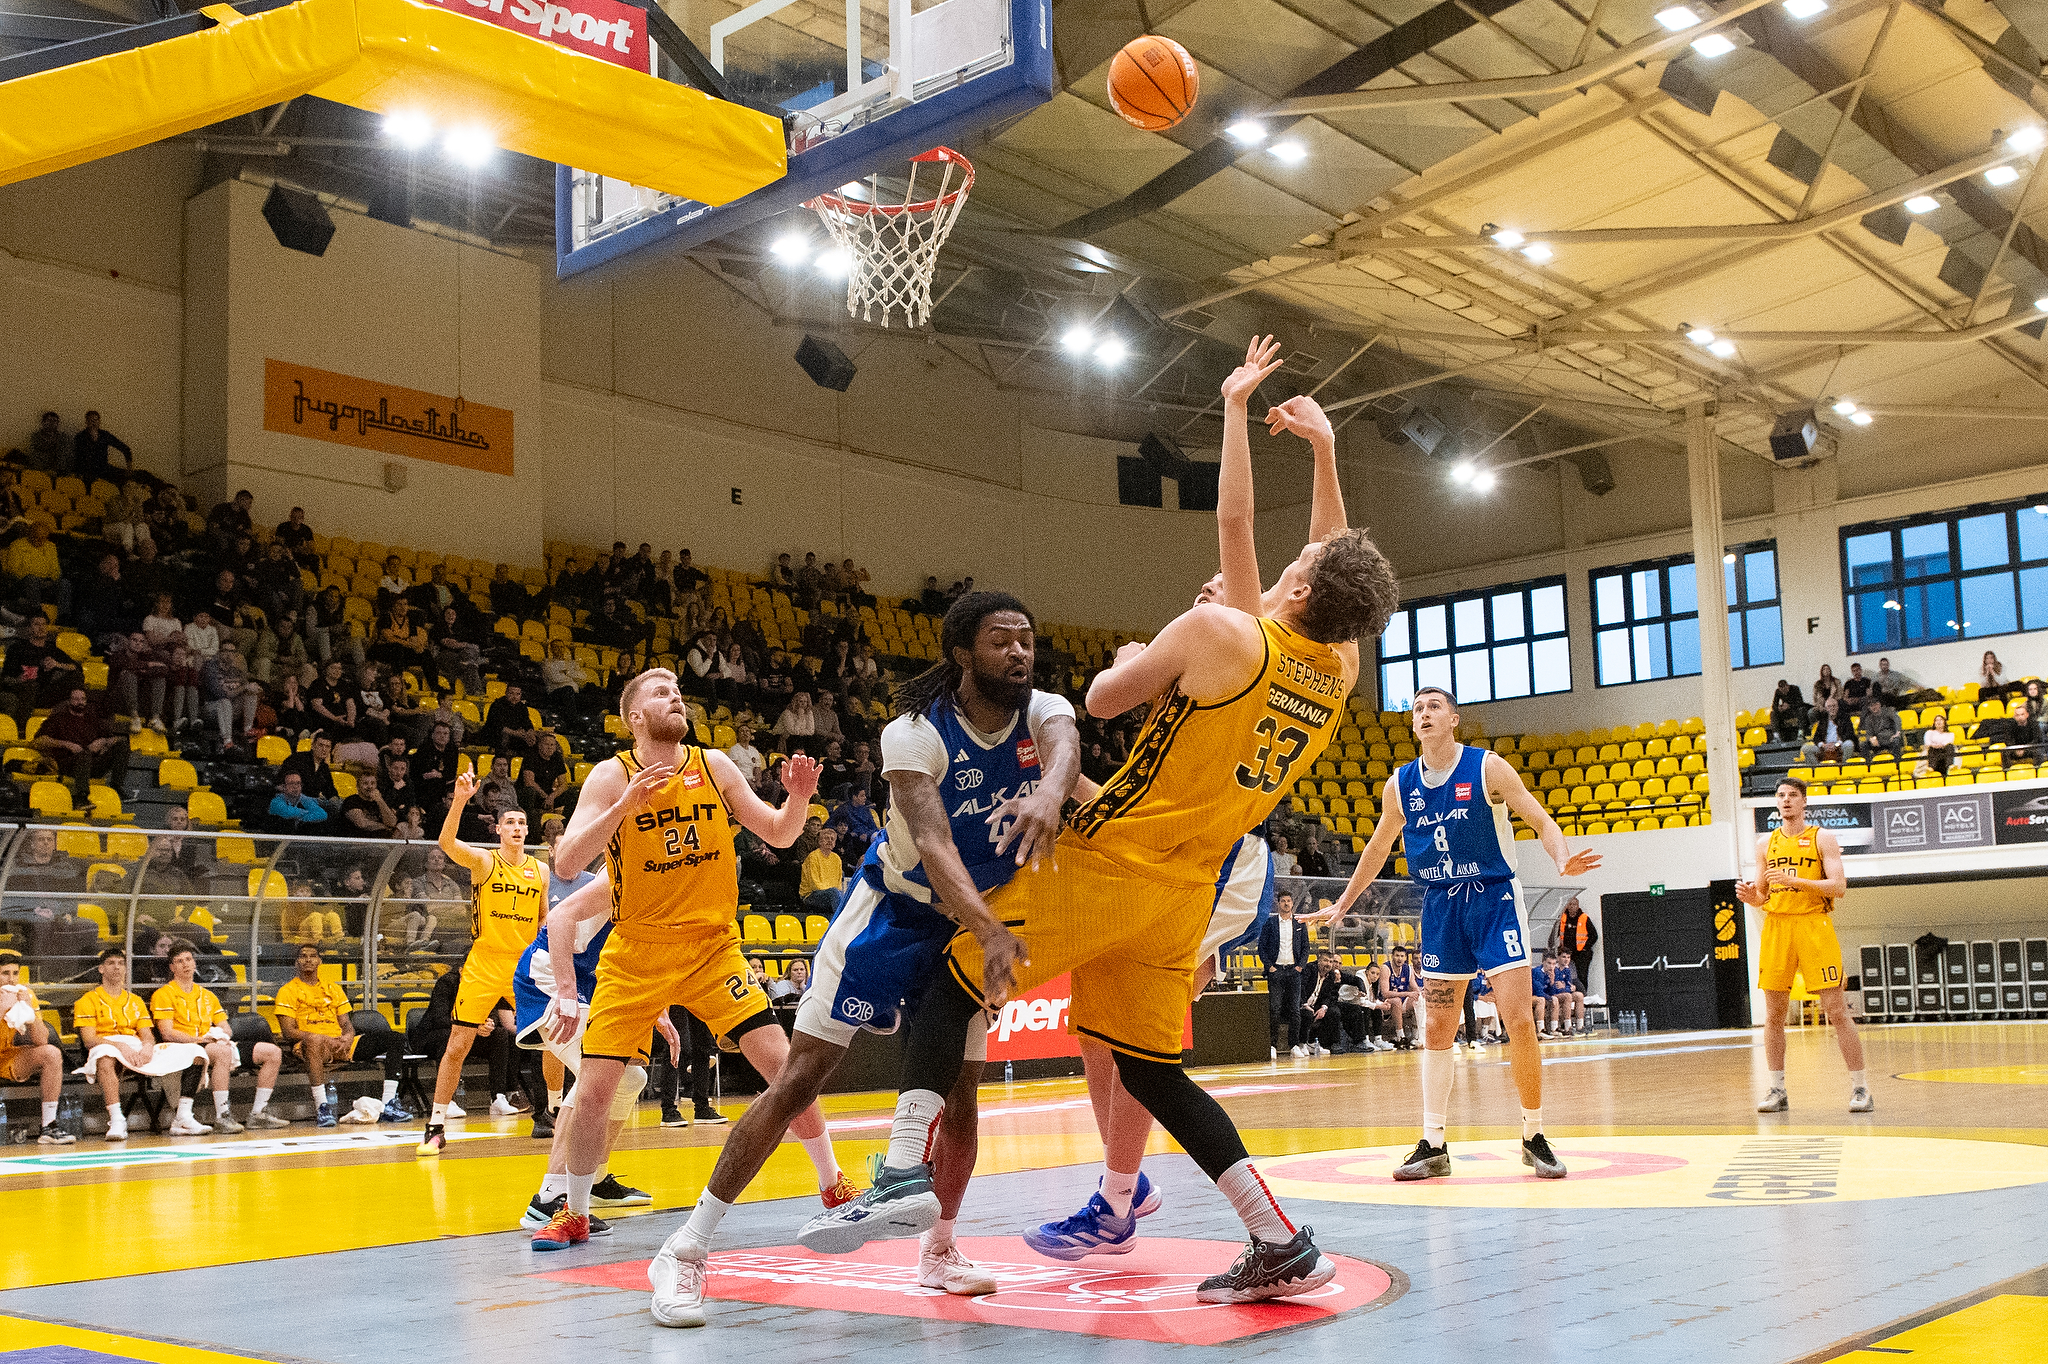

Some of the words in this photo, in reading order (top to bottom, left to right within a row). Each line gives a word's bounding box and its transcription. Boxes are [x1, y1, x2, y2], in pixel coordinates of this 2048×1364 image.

[731, 487, 742, 505] E
[1807, 616, 1819, 634] F
[1276, 652, 1345, 700] STEPHENS
[1268, 687, 1328, 726] GERMANIA
[1233, 714, 1310, 795] 33
[635, 803, 718, 832] SPLIT
[1803, 808, 1849, 819] RVATSKA
[1820, 817, 1859, 827] VOZILA
[1890, 811, 1919, 827] AC
[1944, 806, 1974, 823] AC
[2006, 814, 2048, 826] AutoSer
[664, 823, 701, 858] 24
[1433, 825, 1449, 851] 8
[643, 849, 721, 874] SuperSport
[1419, 866, 1442, 880] HOTEL
[1456, 861, 1480, 876] ALKAR
[1768, 856, 1818, 869] SPLIT
[492, 883, 540, 899] SPLIT
[512, 896, 517, 911] 1
[490, 910, 533, 923] SuperSport
[1503, 929, 1523, 957] 8
[1714, 942, 1740, 961] split
[1821, 965, 1839, 983] 10
[725, 968, 763, 1003] 24
[1705, 1136, 1846, 1201] GERMANIA
